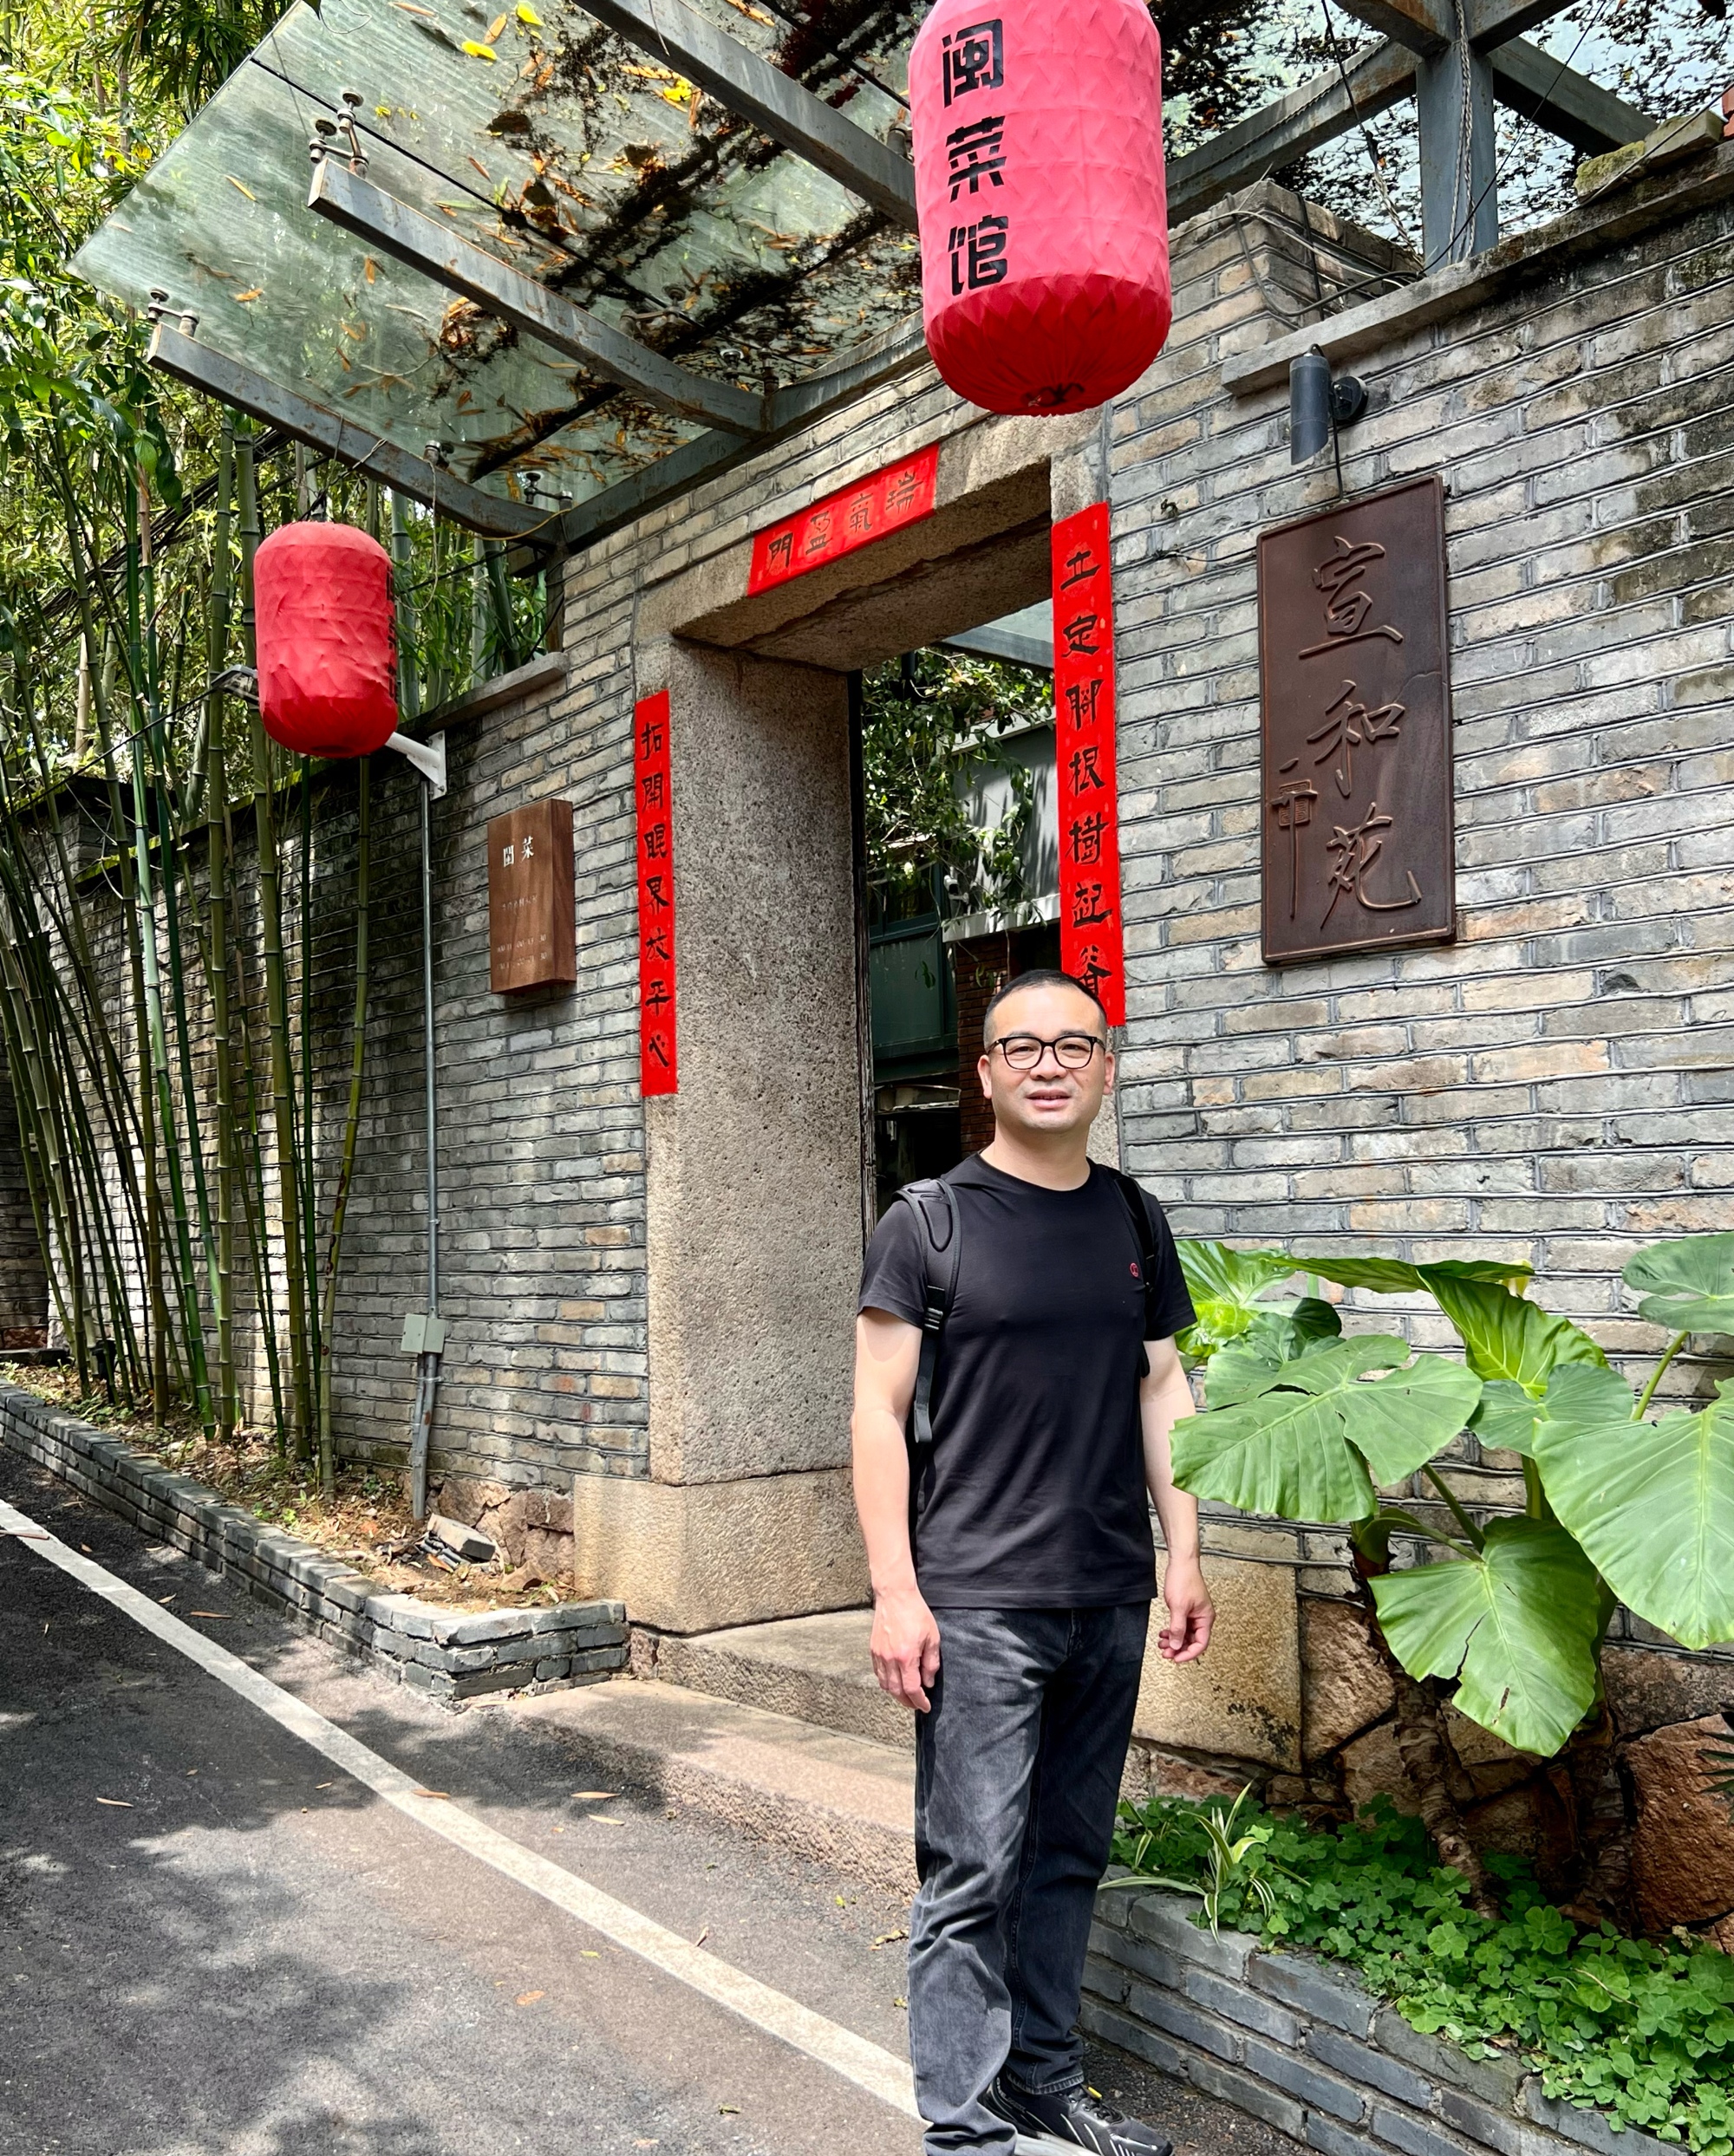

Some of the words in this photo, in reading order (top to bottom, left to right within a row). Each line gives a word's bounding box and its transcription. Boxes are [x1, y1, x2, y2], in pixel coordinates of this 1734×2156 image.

[942, 19, 1008, 296] 闽菜馆
[1299, 536, 1422, 930] 宣和苑
